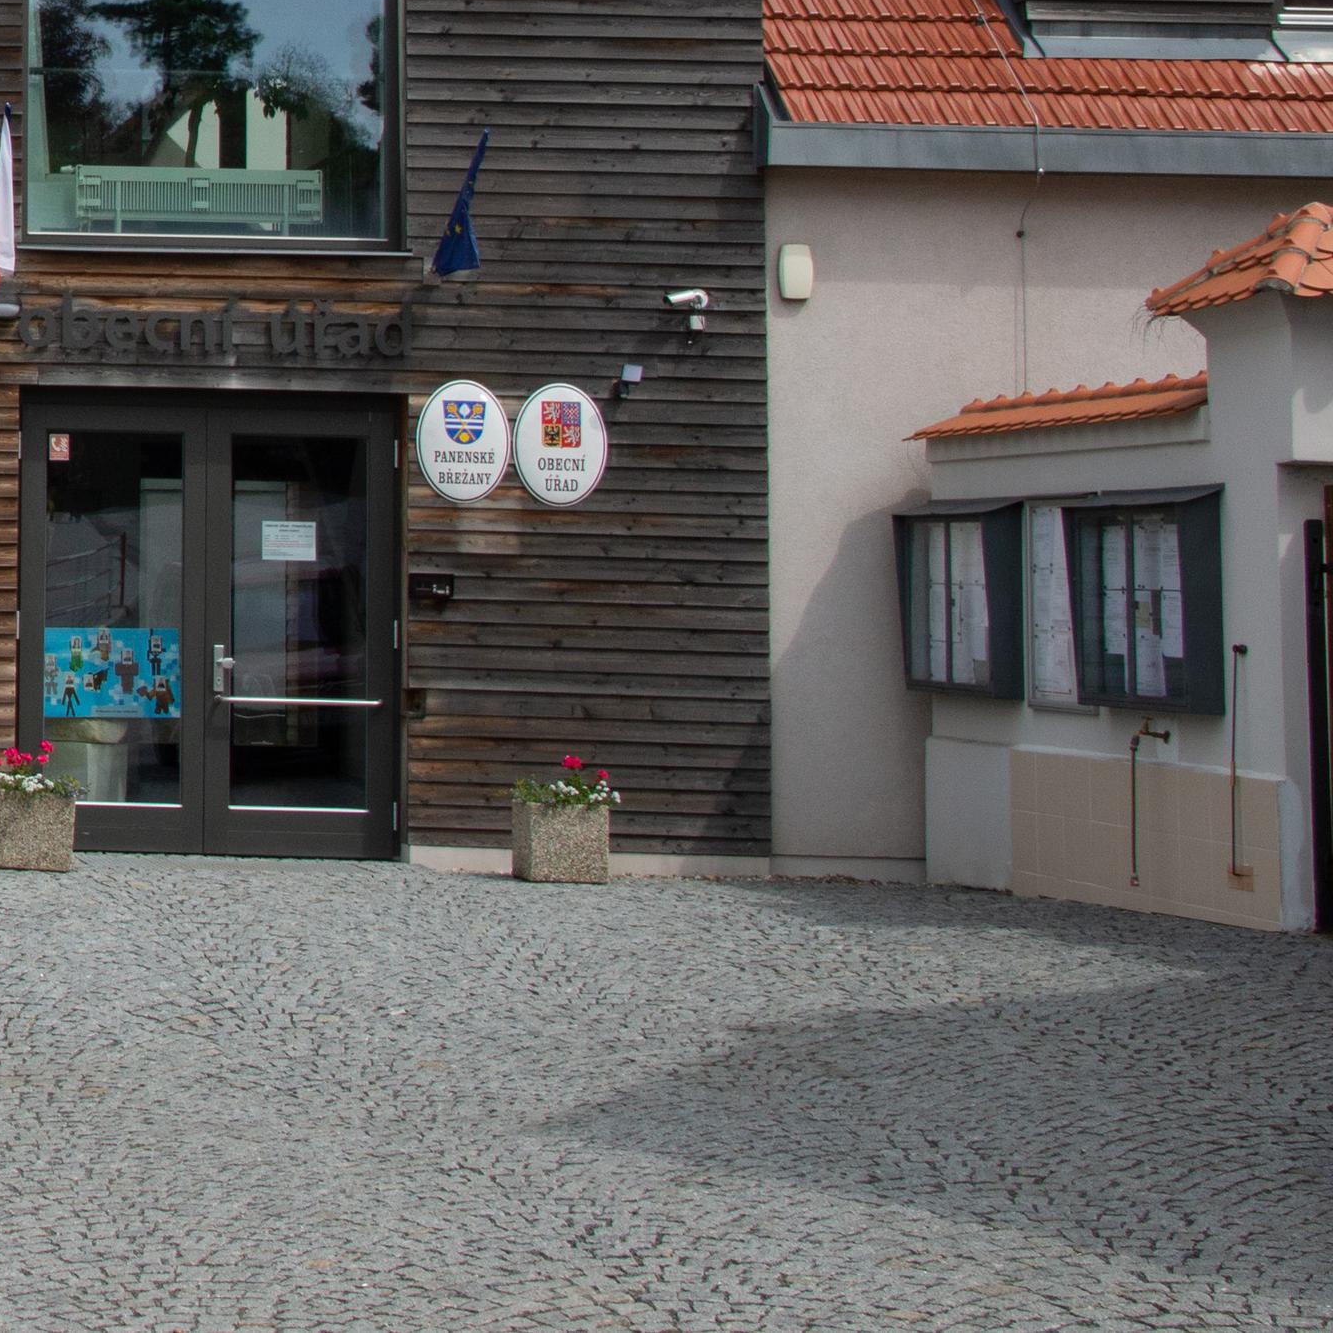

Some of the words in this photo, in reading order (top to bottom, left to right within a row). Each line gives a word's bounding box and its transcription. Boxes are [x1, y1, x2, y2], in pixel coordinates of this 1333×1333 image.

[434, 448, 495, 465] PANENSKÉ
[538, 455, 585, 472] OBECNÍ
[438, 469, 492, 485] BŘEŽANY
[545, 475, 579, 492] ÚŘAD
